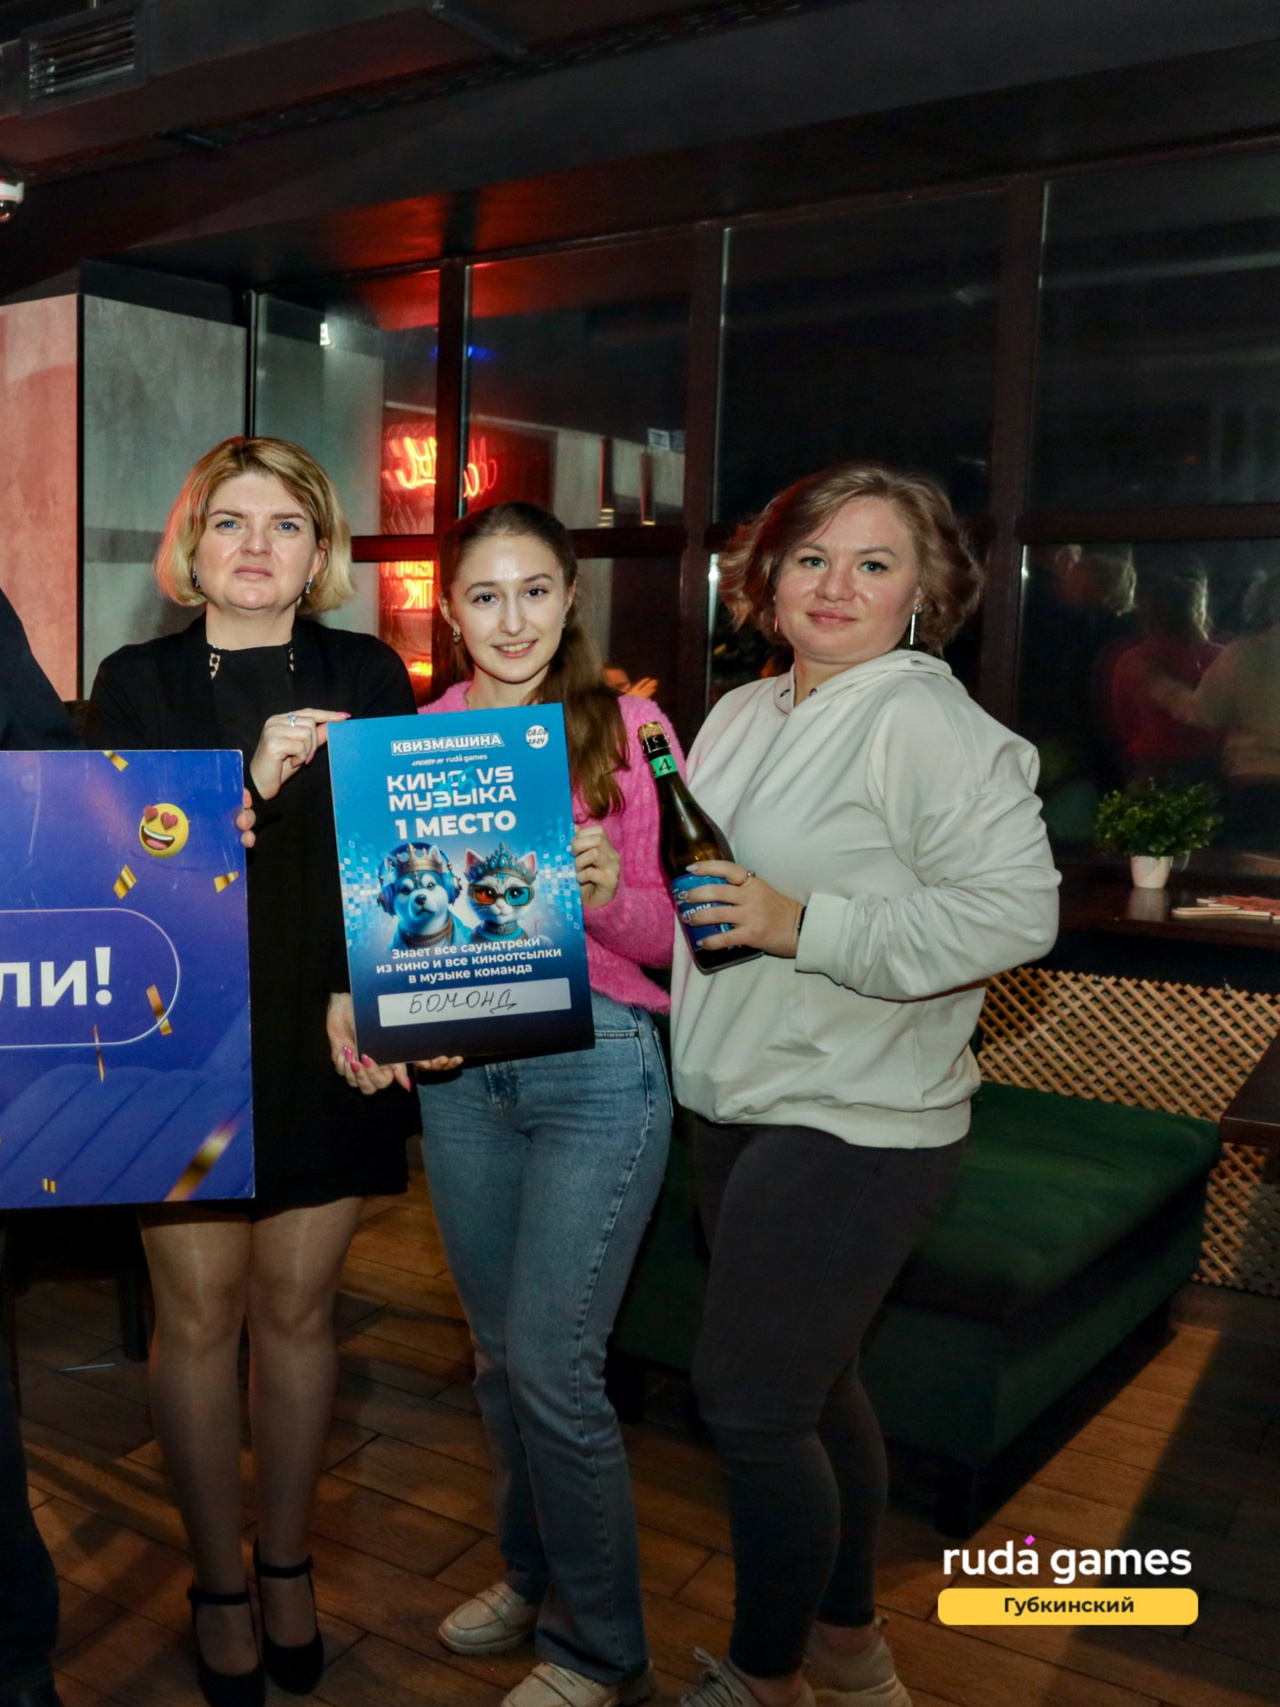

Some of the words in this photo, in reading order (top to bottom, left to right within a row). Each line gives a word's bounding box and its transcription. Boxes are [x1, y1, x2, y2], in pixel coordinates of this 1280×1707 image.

[392, 734, 502, 753] КВИЗМАШИНА
[463, 754, 488, 764] games
[387, 770, 468, 792] КИНО
[476, 766, 514, 785] VS
[389, 785, 517, 812] МУЗЫКА
[395, 819, 407, 839] 1
[415, 810, 517, 838] МЕСТО
[376, 964, 392, 974] из
[395, 961, 429, 972] кино
[432, 959, 441, 969] и
[445, 957, 468, 967] все
[472, 948, 562, 965] киноотсылки
[392, 948, 430, 959] Знает
[435, 945, 457, 955] все
[460, 938, 540, 953] саундтреки
[408, 974, 417, 984] в
[420, 969, 470, 984] музыке
[474, 963, 532, 978] команда
[409, 988, 518, 1014] БОМОНД
